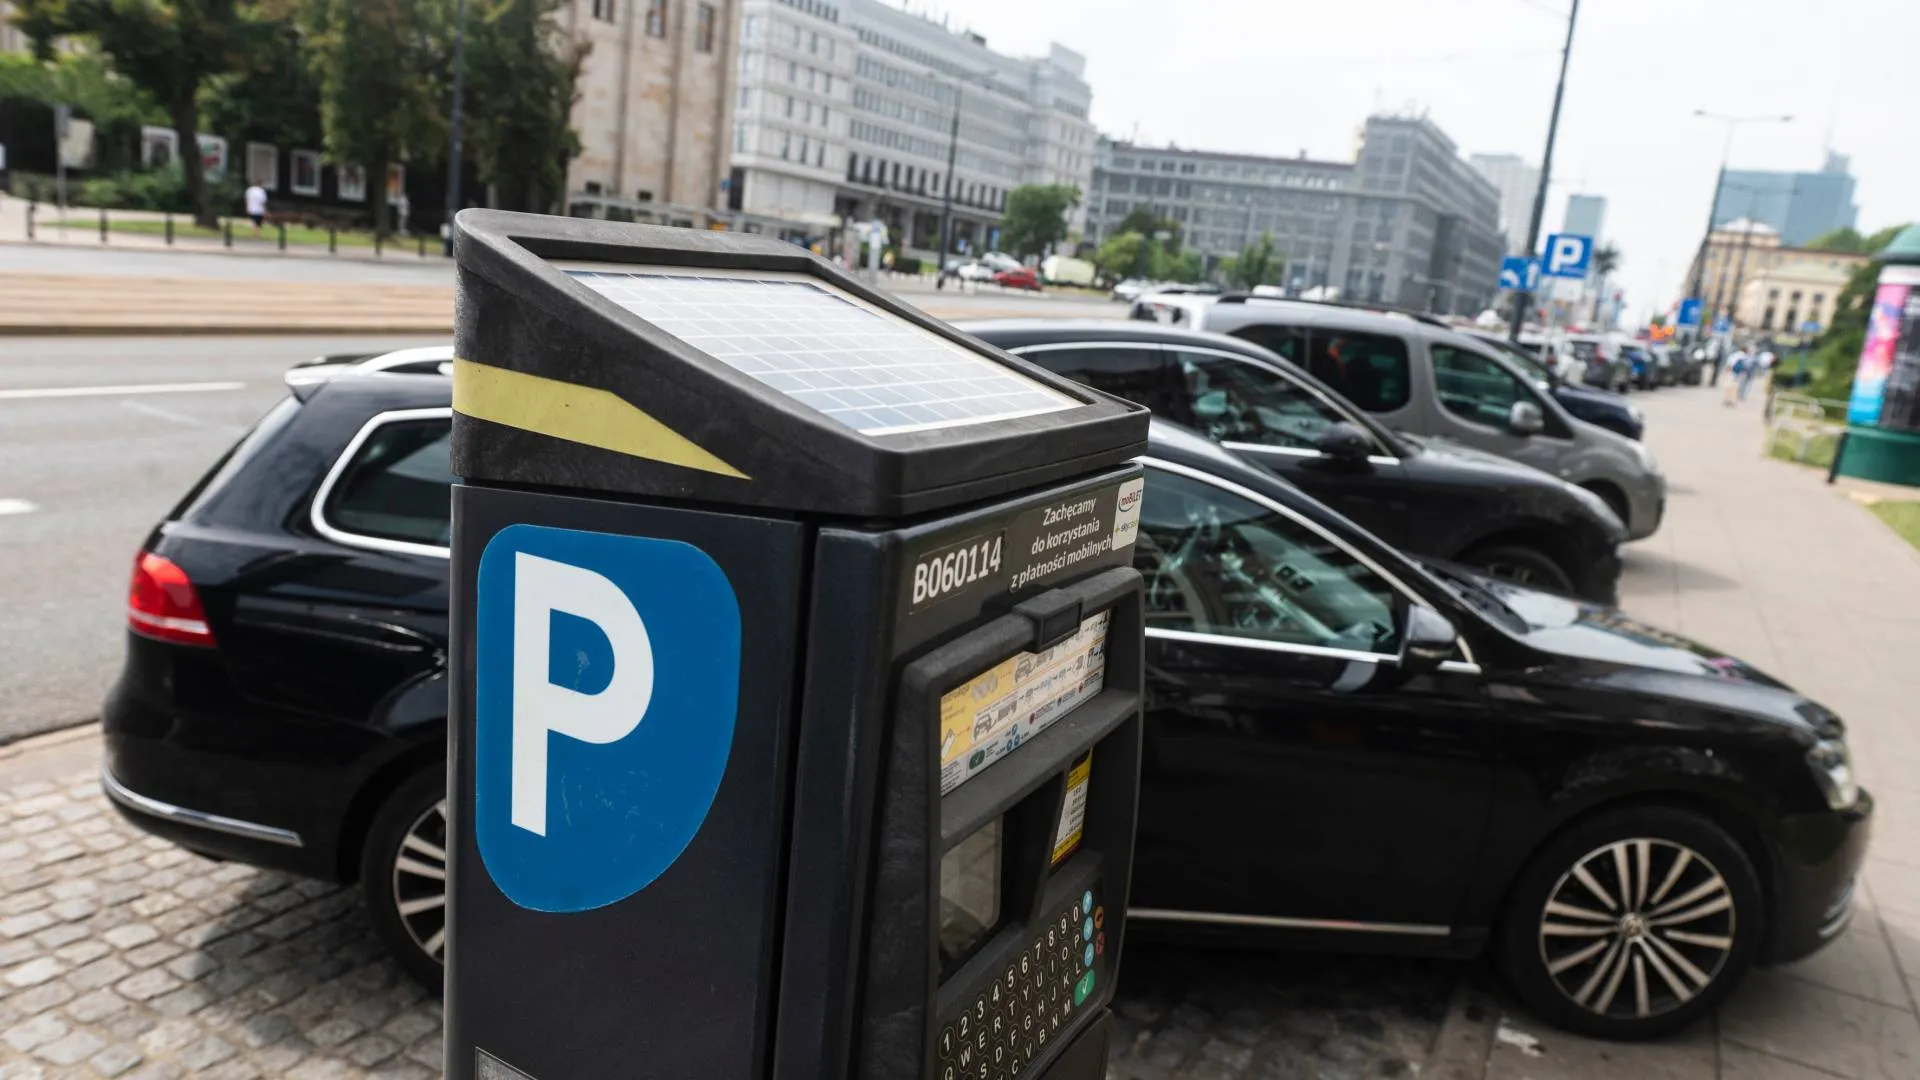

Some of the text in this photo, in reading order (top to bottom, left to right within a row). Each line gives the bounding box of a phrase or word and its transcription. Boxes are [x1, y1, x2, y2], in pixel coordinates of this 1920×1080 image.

[1548, 237, 1584, 273] P
[1031, 517, 1100, 555] do korzystania
[1043, 498, 1097, 526] Zachęcamy
[912, 536, 1002, 604] B060114
[1011, 534, 1112, 588] z płatności mobilnych
[511, 551, 654, 837] P
[944, 906, 1079, 1052] 1 2 3 4 5 6 7 8 9 0
[961, 1046, 971, 1068] W
[979, 1031, 986, 1049] E
[994, 1016, 1001, 1034] R
[1008, 1000, 1015, 1016] T
[1023, 985, 1029, 1001] Y
[1036, 971, 1043, 988] U
[1074, 934, 1080, 949] P
[980, 961, 1080, 1079] S D F G H J K L
[1012, 999, 1071, 1075] C V B N M
